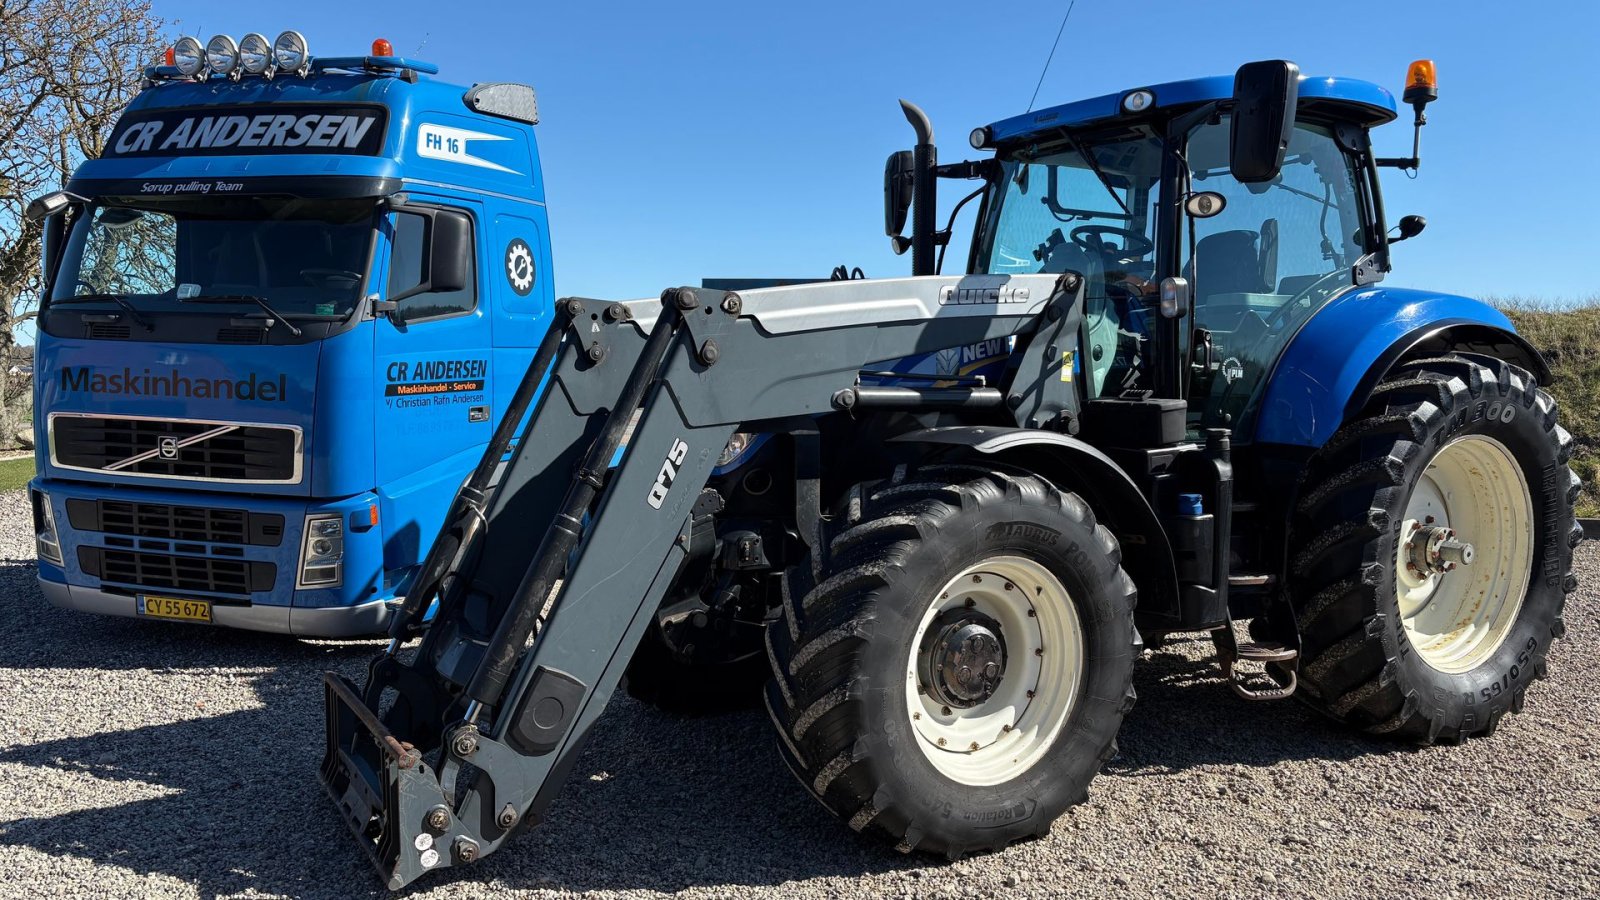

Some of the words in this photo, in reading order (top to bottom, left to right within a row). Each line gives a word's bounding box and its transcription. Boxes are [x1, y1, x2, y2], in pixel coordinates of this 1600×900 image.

[115, 121, 163, 153] CR
[158, 115, 375, 149] ANDERSEN
[426, 132, 442, 150] FH
[446, 137, 459, 154] 16
[141, 182, 172, 193] Sørup
[174, 181, 210, 193] pulling
[215, 181, 243, 191] Team
[938, 284, 1031, 306] Quicke
[963, 336, 1001, 363] NEW
[387, 362, 408, 382] CR
[412, 360, 487, 380] ANDERSEN
[61, 366, 287, 401] Maskinhandel
[397, 383, 448, 394] Maskinhandel
[453, 382, 476, 391] Service
[396, 398, 431, 408] Christian
[433, 395, 450, 405] Rafn
[452, 394, 484, 404] Andersen
[1004, 525, 1060, 546] TAURUS
[146, 599, 161, 614] CY
[166, 601, 181, 615] 55
[184, 602, 208, 617] 672
[1480, 636, 1538, 703] 650/65
[1462, 691, 1476, 705] R
[963, 806, 1013, 823] Rotation
